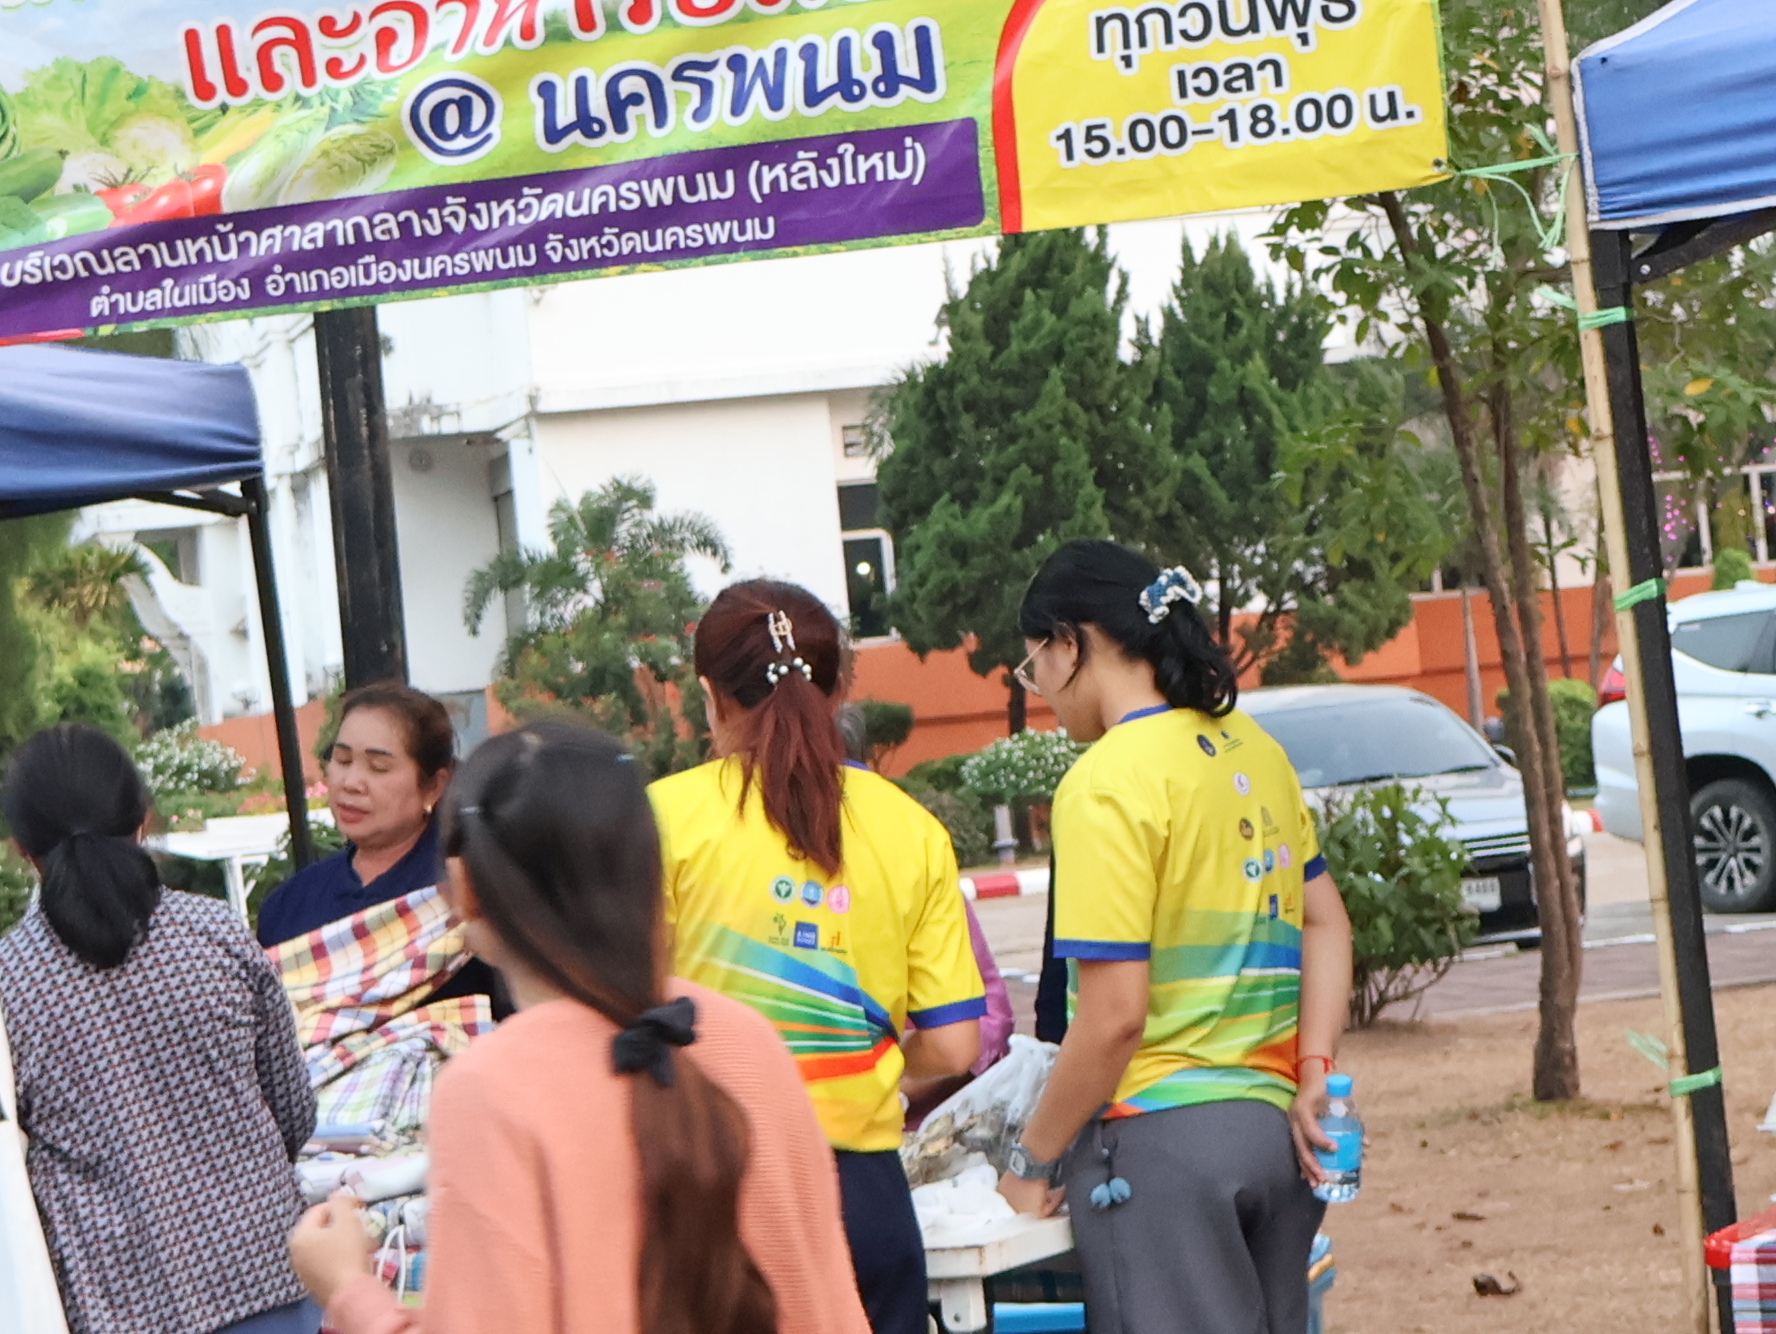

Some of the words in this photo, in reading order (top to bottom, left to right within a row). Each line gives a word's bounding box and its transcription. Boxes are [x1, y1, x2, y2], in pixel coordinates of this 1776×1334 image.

[411, 79, 492, 154] @
[540, 21, 937, 144] นครพนม
[1178, 57, 1283, 99] เวลา
[1368, 90, 1415, 123] น.
[0, 170, 735, 288] บริเวณลานหน้าศาลากลางจังหวัดนครพนม
[748, 138, 926, 202] (หลังใหม่)
[91, 272, 250, 317] ตำบลในเมือง
[266, 242, 537, 297] อำเภอเมืองนครพนม
[546, 214, 776, 265] จังหวัดนครพนม
